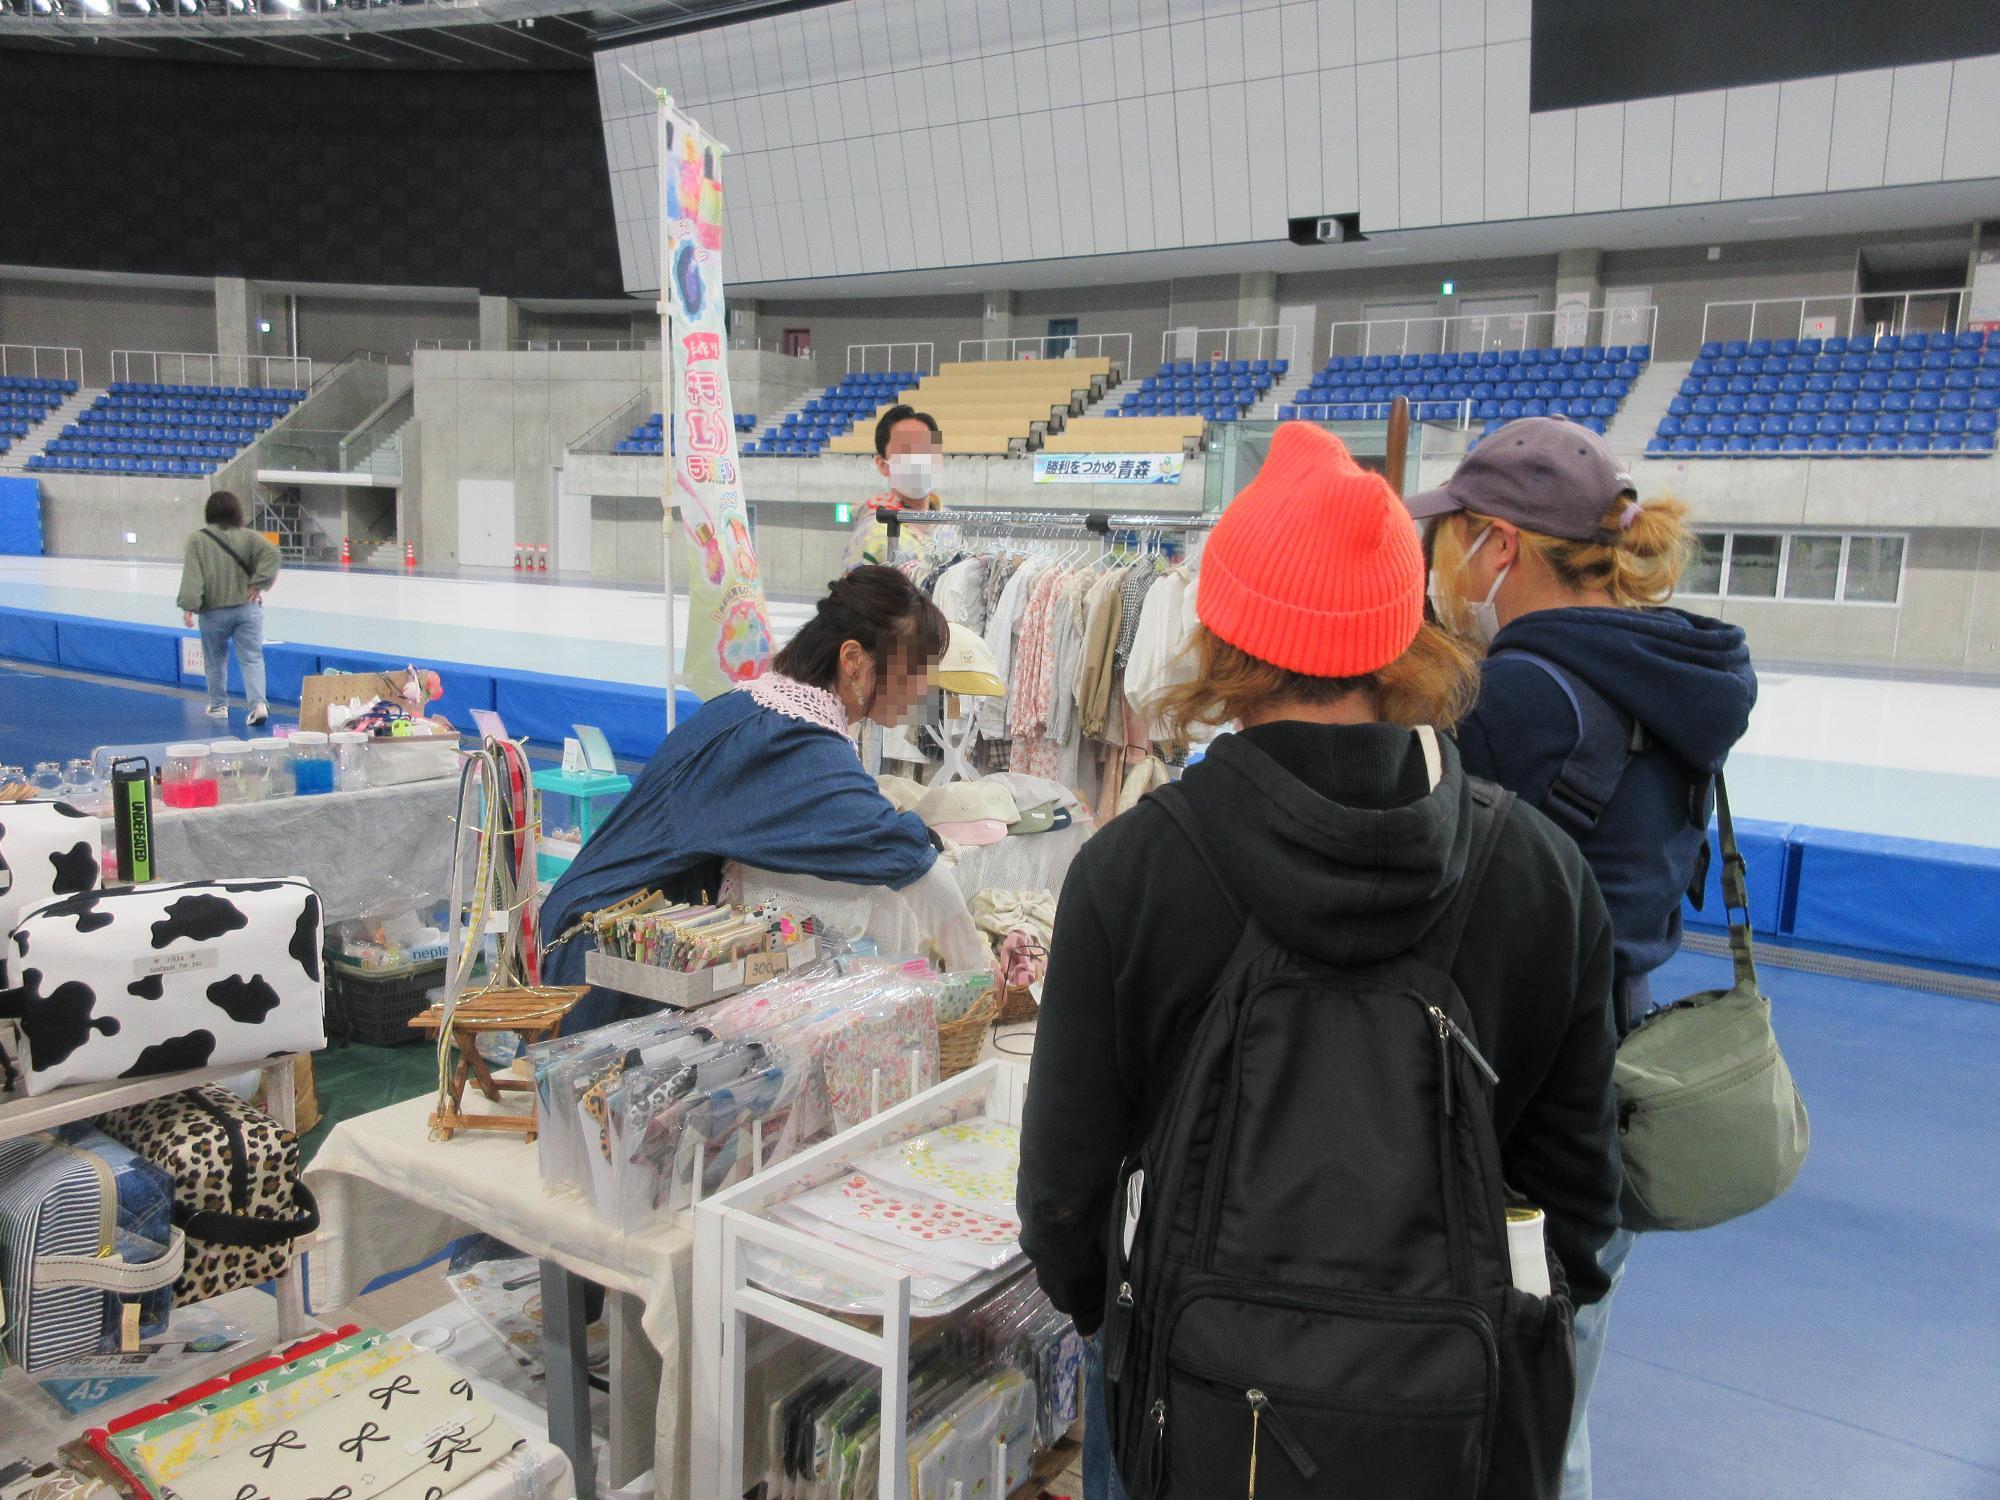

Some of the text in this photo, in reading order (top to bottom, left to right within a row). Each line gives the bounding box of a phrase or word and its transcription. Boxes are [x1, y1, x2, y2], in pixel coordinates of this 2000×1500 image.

[1045, 459, 1152, 479] 勝利をつかめ青森
[131, 800, 147, 863] UNDEFEATED
[66, 1378, 114, 1401] A5
